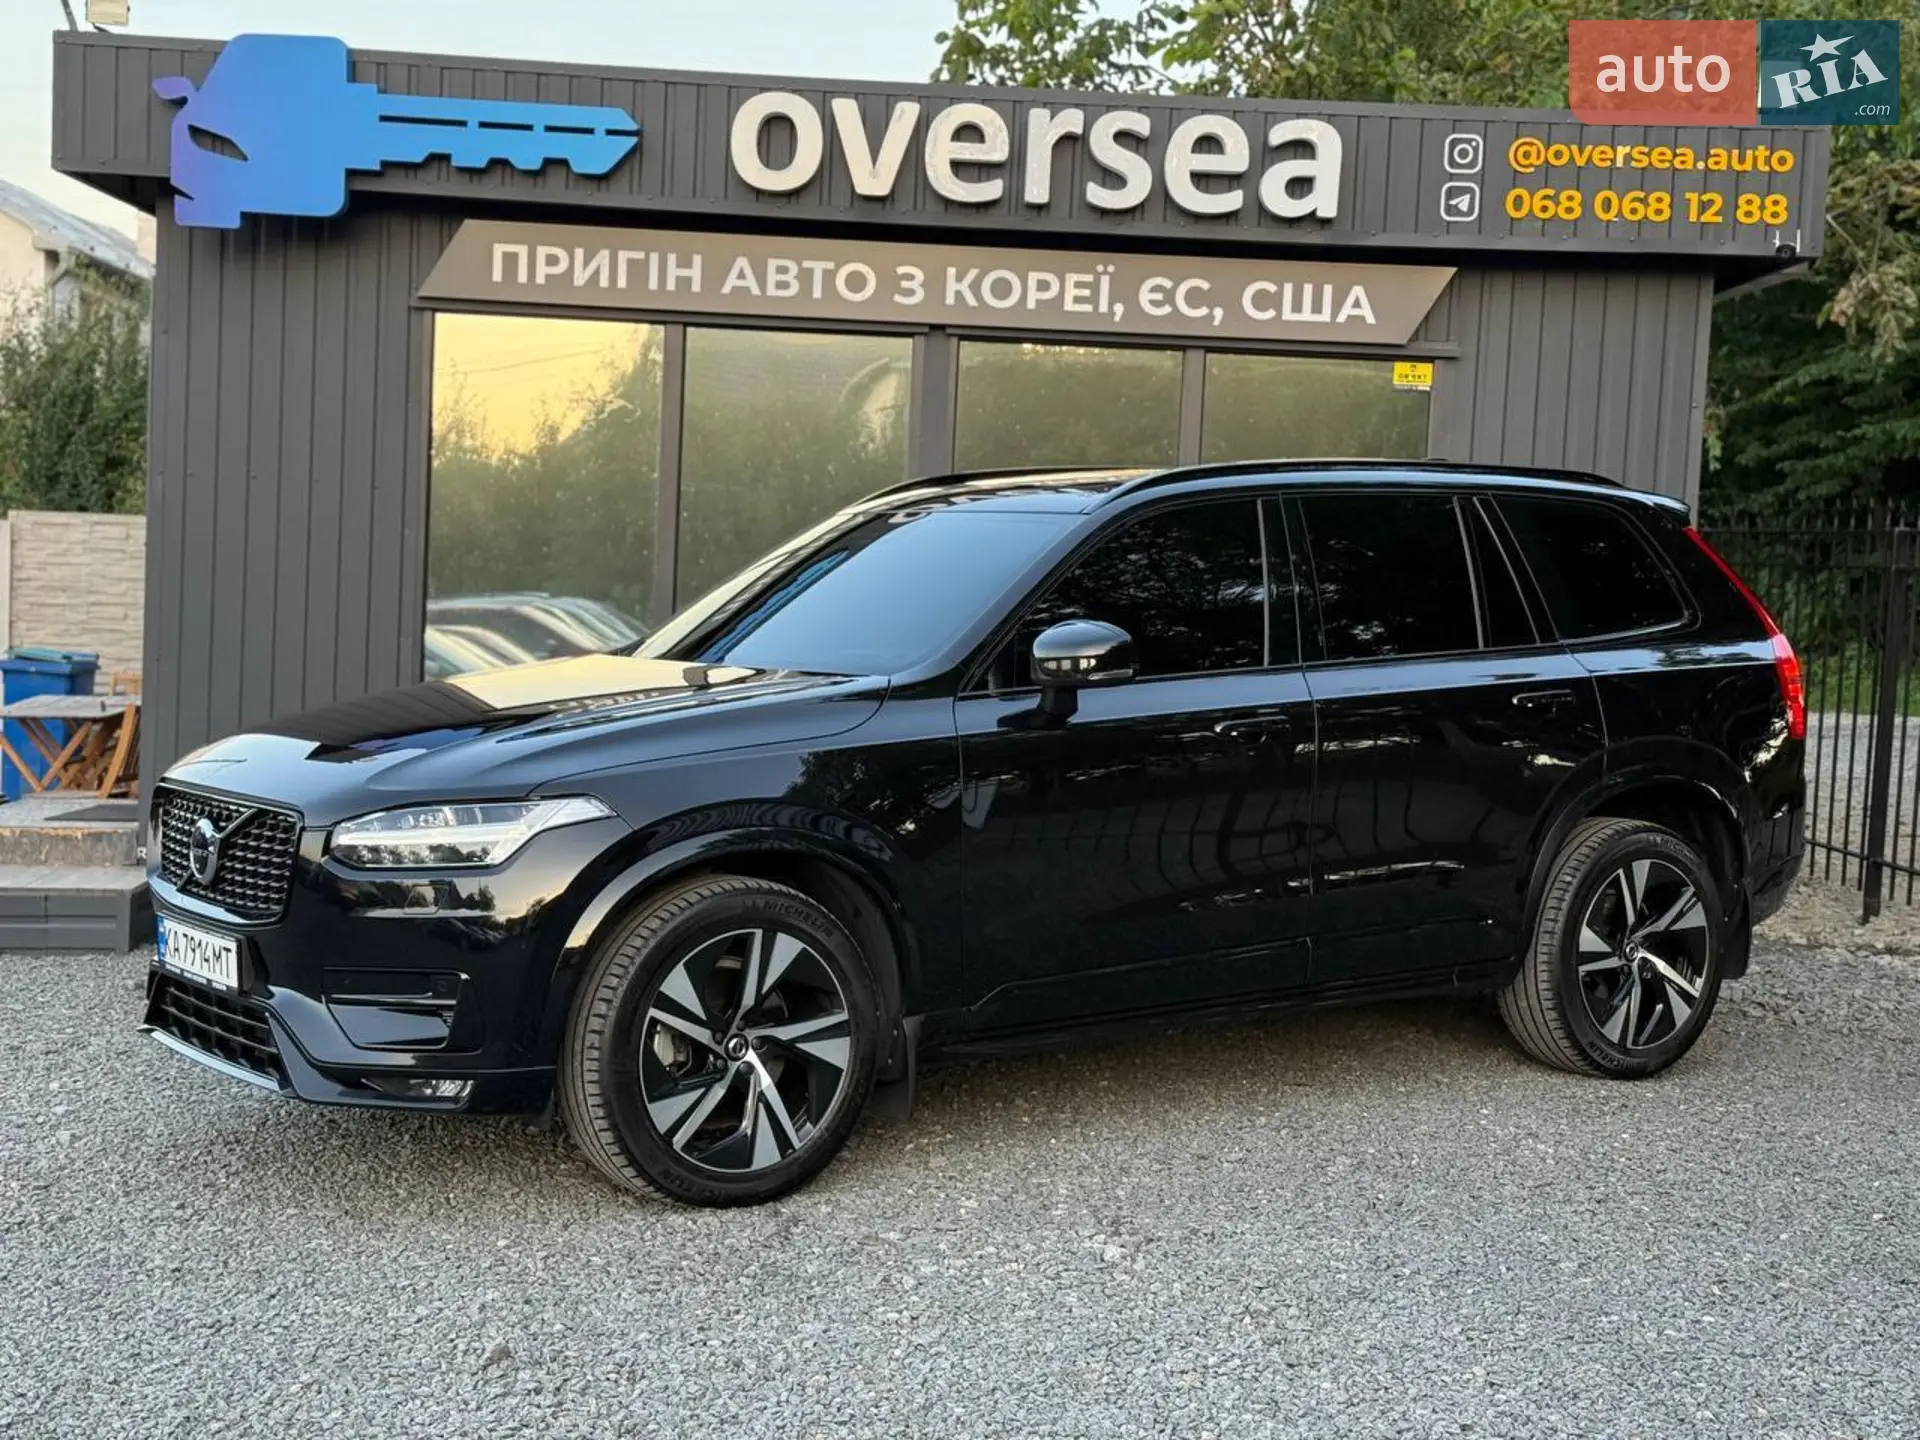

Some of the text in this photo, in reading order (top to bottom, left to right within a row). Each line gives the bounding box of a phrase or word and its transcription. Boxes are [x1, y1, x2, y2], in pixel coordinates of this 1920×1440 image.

[730, 92, 1343, 218] oversea
[1508, 137, 1795, 173] @oversea.auto
[1505, 187, 1788, 225] 068 068 12 88
[491, 243, 1377, 327] ПРИГІН АВТО З КОРЕЇ, ЄС, США
